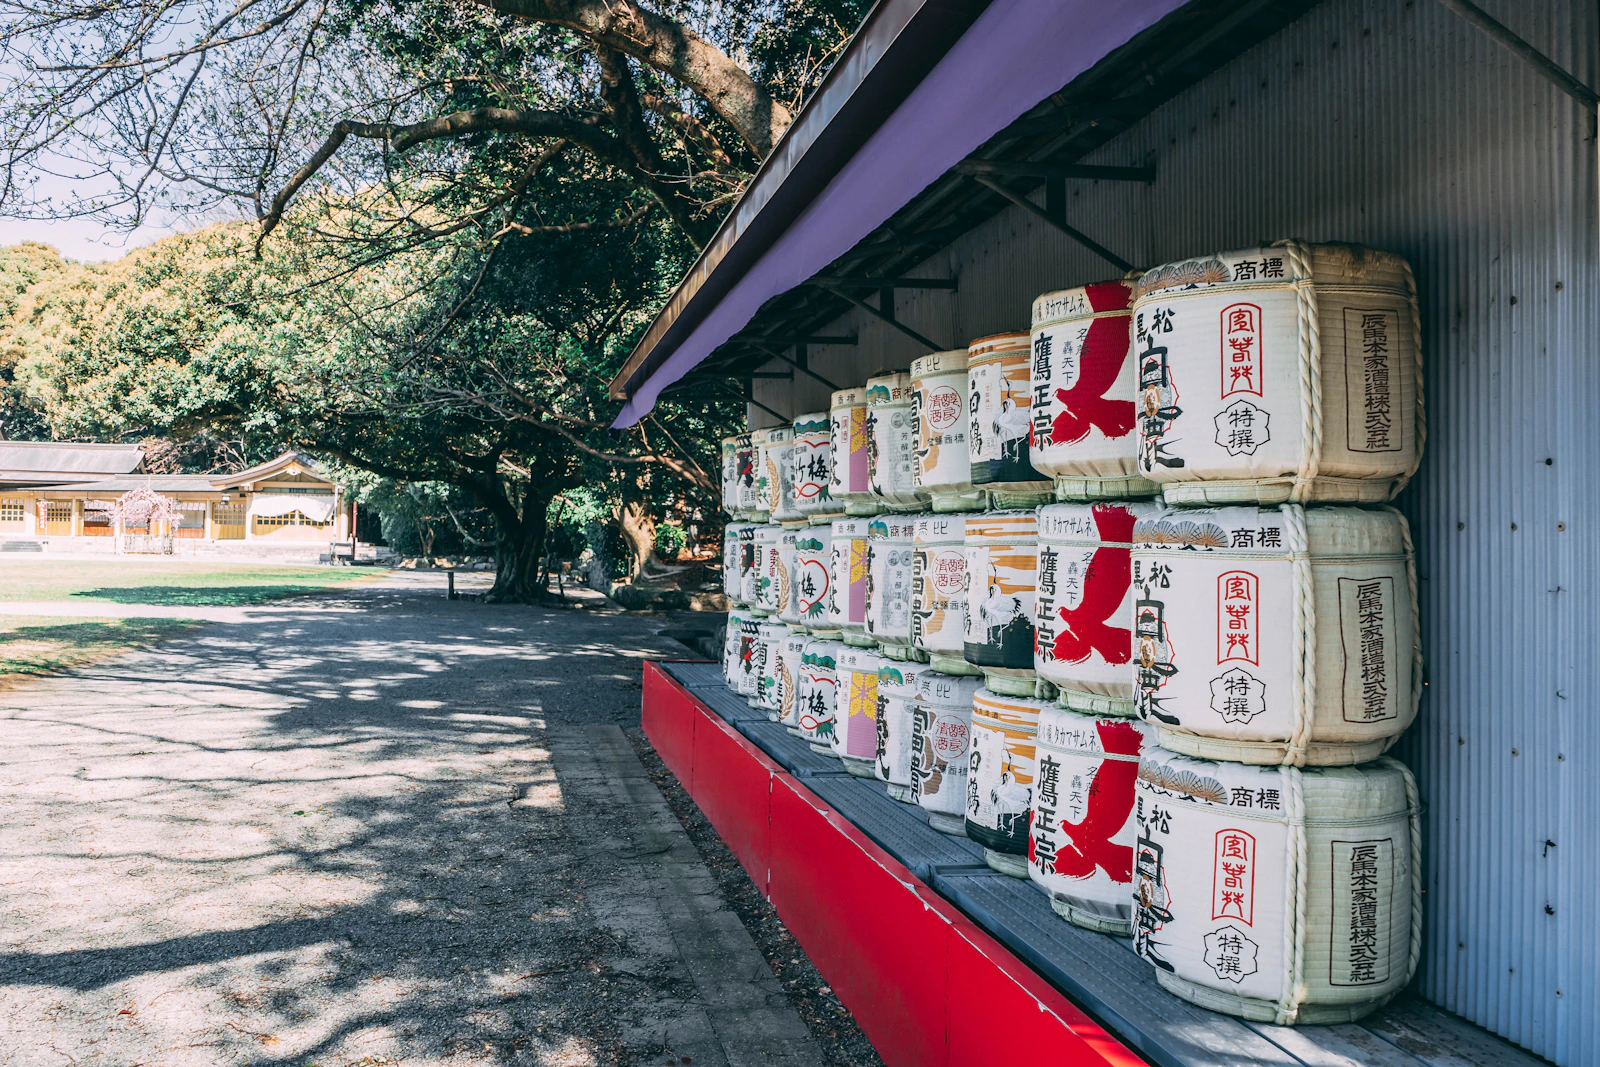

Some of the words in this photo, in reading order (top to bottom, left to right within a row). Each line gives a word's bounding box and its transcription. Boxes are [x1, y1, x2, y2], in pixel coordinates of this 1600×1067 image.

[1232, 257, 1285, 283] 商標
[1032, 331, 1055, 452] 鷹正宗
[1360, 313, 1392, 450] 辰馬本家酒造株式会社
[1228, 407, 1256, 448] 特撰
[1230, 527, 1282, 549] 商標
[1036, 545, 1059, 664] 鷹正宗
[1356, 581, 1388, 719] 辰馬本家酒造株式会社
[1223, 675, 1252, 717] 特撰
[1034, 754, 1062, 876] 鷹正宗
[1229, 786, 1281, 811] 商標
[1348, 845, 1378, 982] 辰馬本家酒造株式会社
[1216, 933, 1244, 976] 特撰
